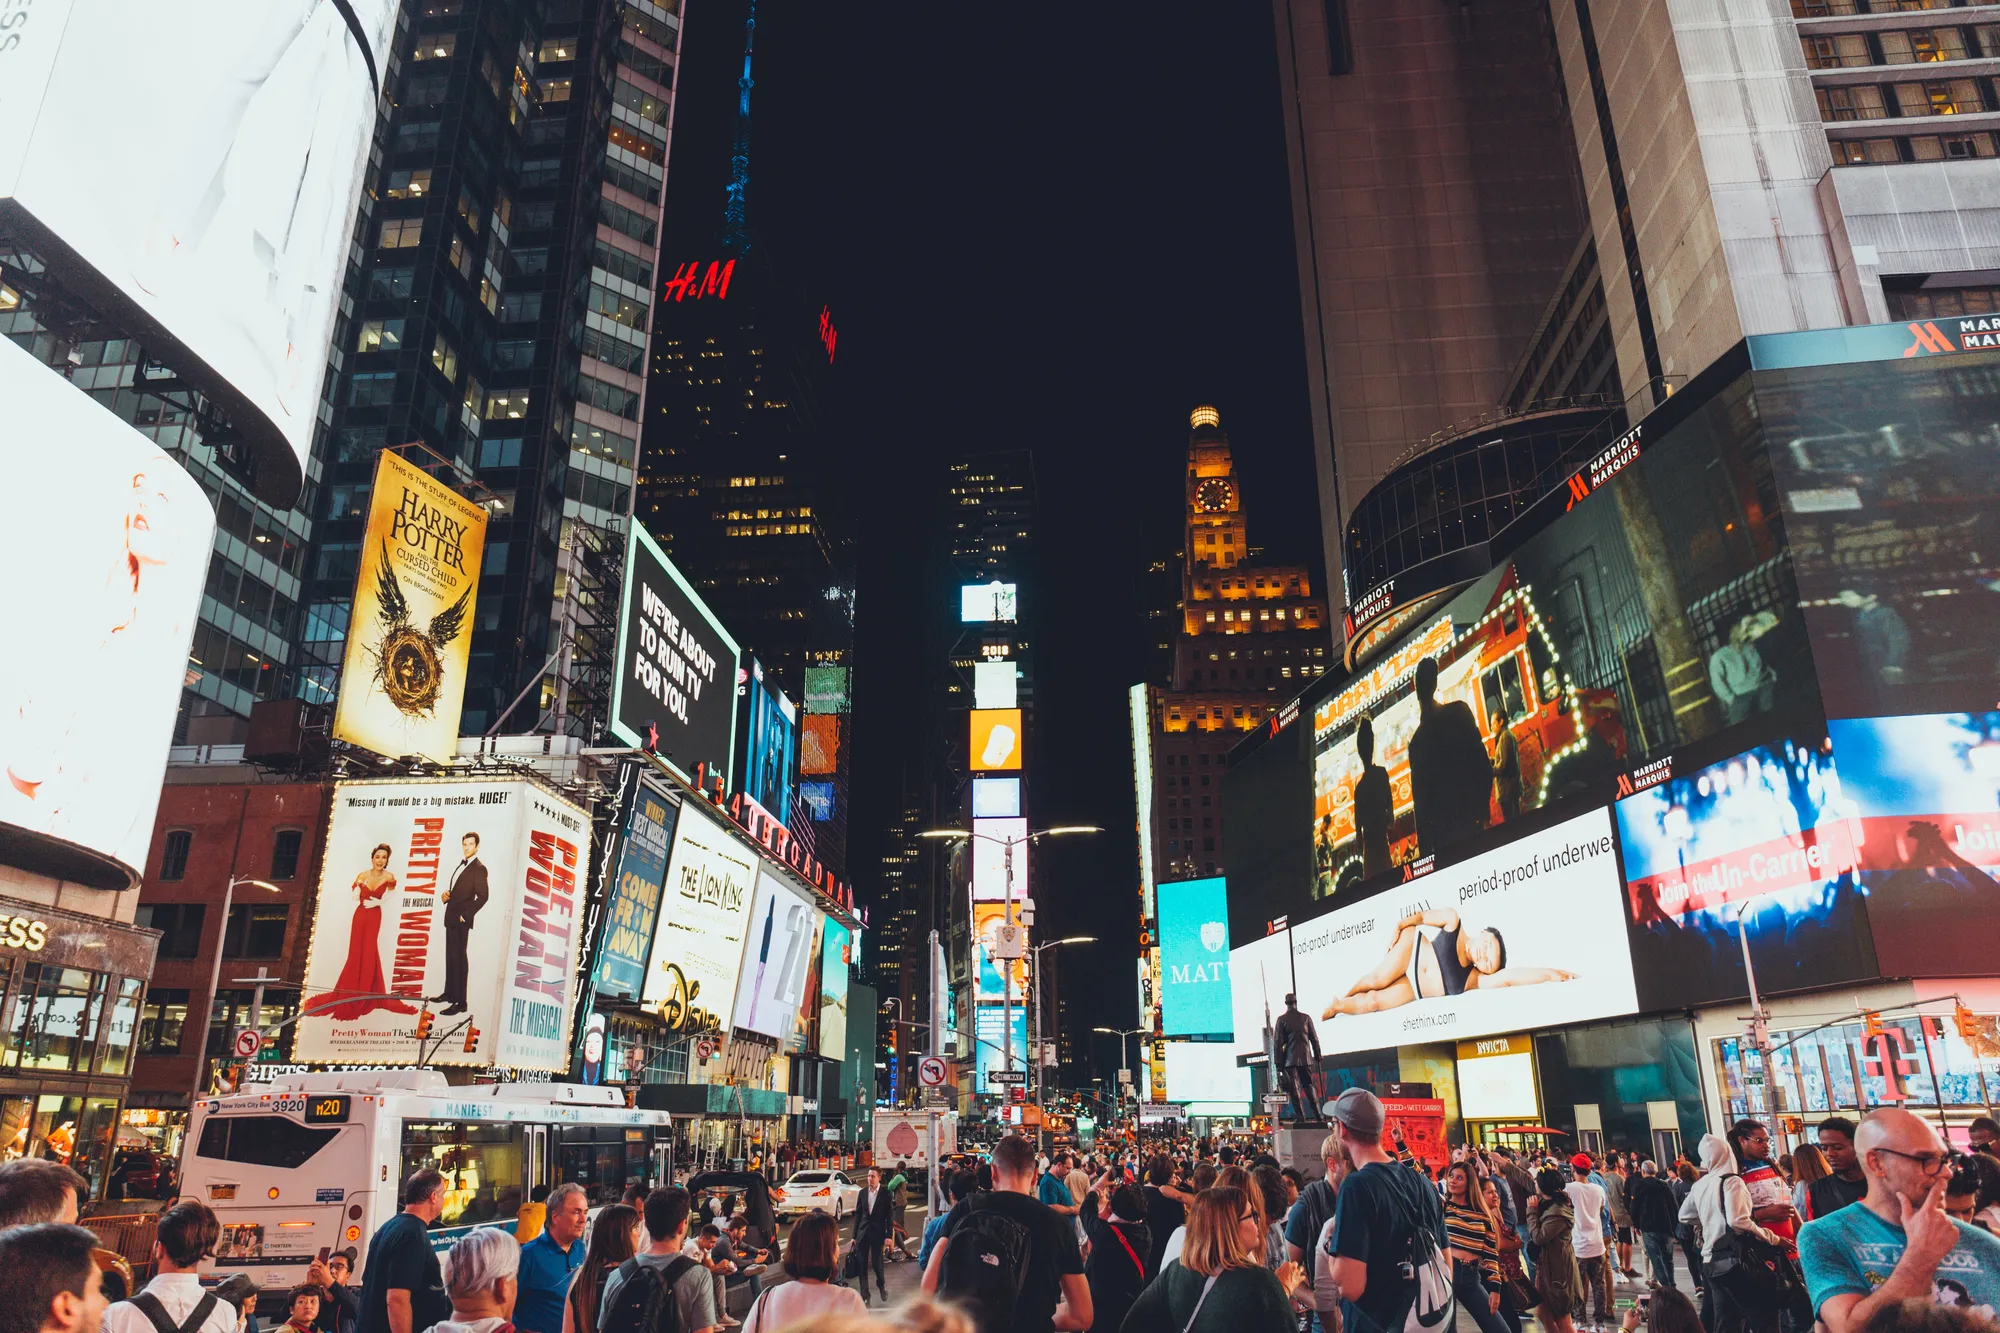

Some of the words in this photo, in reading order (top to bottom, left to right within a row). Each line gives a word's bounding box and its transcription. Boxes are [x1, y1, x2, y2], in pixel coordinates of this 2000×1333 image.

[663, 259, 736, 303] H&M
[1590, 425, 1642, 474] MARRIOTT
[1592, 444, 1639, 487] MARQUIS
[408, 473, 414, 481] IS
[415, 477, 428, 489] THE
[428, 485, 448, 502] STUFF
[449, 497, 457, 508] OF
[400, 486, 468, 548] HARRY
[390, 509, 467, 576] POTTER
[417, 552, 428, 562] AND
[429, 558, 439, 567] THE
[396, 547, 430, 572] CURSED
[431, 565, 457, 587] CHILD
[404, 563, 417, 572] PARTS
[427, 575, 437, 584] AND
[437, 581, 448, 590] TWO
[403, 575, 413, 585] ON
[413, 580, 445, 601] BROADWAY
[1354, 580, 1395, 615] MARRIOTT
[1355, 597, 1391, 628] MARQUIS
[639, 616, 657, 656] TO
[658, 637, 686, 687] RUIN
[686, 666, 702, 701] TV
[679, 627, 716, 683] ABOUT
[982, 645, 1009, 656] 2018
[635, 651, 660, 700] FOR
[662, 677, 689, 725] YOU.
[1279, 697, 1300, 719] MARRIOTT
[1633, 755, 1673, 780] MARRIOTT
[1635, 768, 1671, 789] MARQUIS
[379, 797, 385, 806] it
[387, 796, 409, 807] would
[411, 796, 421, 806] be
[423, 798, 428, 806] a
[430, 796, 442, 808] big
[444, 795, 476, 806] mistake.
[646, 819, 668, 850] MUSICAL
[403, 817, 445, 895] PRETTY
[762, 815, 854, 912] BROADWAY
[1412, 853, 1435, 869] MARRIOTT
[1413, 863, 1434, 877] MARQUIS
[620, 871, 658, 911] COME
[680, 865, 698, 892] THE
[698, 864, 722, 903] LION
[721, 872, 743, 910] KING
[1458, 854, 1540, 906] period-proof
[1657, 881, 1690, 906] Join
[1693, 871, 1717, 896] the
[1712, 842, 1831, 892] Un-Carrier
[402, 897, 413, 908] THE
[412, 897, 434, 908] MUSICAL
[514, 829, 556, 993] WOMAN
[540, 836, 579, 1005] PRETTY
[1331, 918, 1376, 944] underwear
[391, 909, 433, 998] WOMAN
[607, 930, 650, 963] AWAY
[1171, 961, 1233, 984] MAT
[509, 997, 525, 1034] THE
[526, 1001, 563, 1041] MUSICAL
[1403, 1010, 1457, 1031] shethinx.com
[1476, 1038, 1510, 1055] INVICTA
[1860, 1027, 1913, 1101] T
[272, 1100, 305, 1113] 3920
[446, 1102, 493, 1117] MANIFEST
[1407, 1104, 1420, 1112] SWEET
[1422, 1104, 1443, 1112] CHURROS
